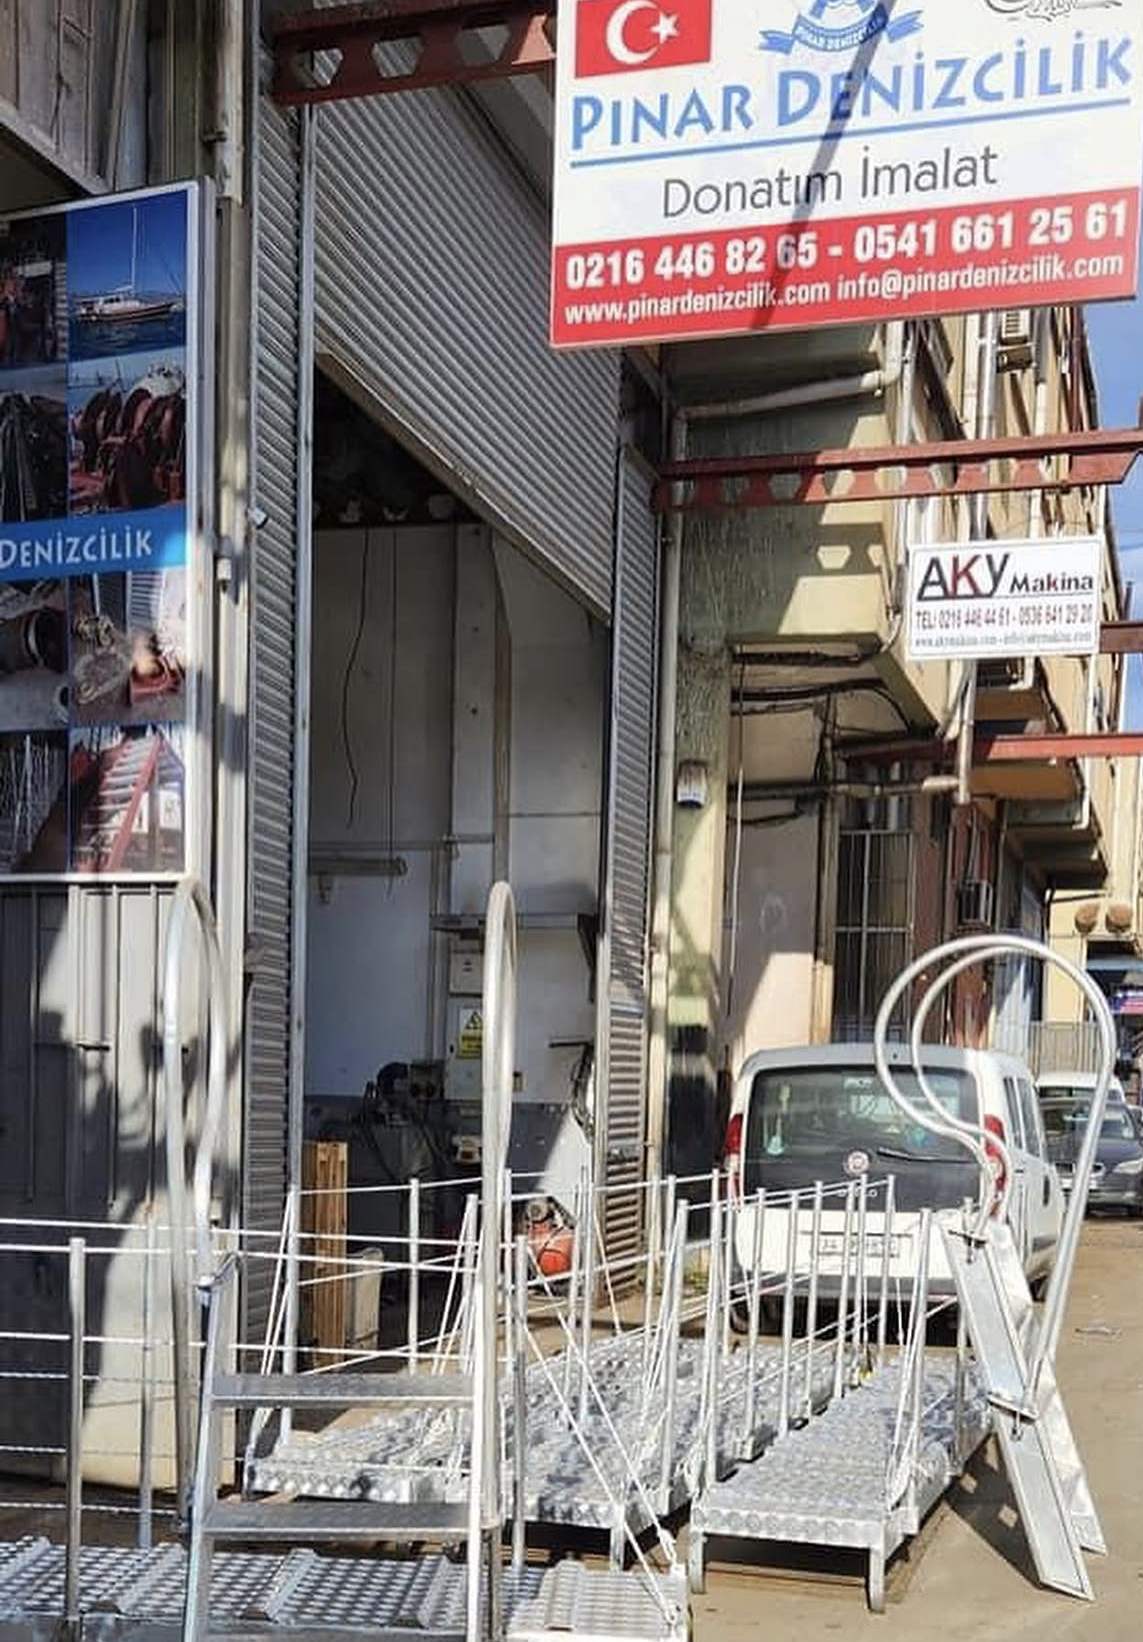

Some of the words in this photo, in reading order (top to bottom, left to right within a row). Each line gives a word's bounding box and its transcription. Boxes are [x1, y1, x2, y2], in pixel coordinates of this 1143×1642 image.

[570, 84, 752, 152] PINAR
[776, 31, 1133, 128] DENİZCİLİK
[663, 169, 843, 219] Donatım
[861, 145, 998, 199] İmalat
[566, 249, 645, 290] 0216
[654, 240, 714, 280] 446
[725, 235, 766, 276] 82
[776, 231, 818, 269] 65
[853, 219, 937, 265] 0541
[951, 214, 1013, 254] 661
[1029, 206, 1074, 246] 25
[1085, 199, 1128, 240] 61
[564, 281, 830, 325] www.pinardenizcilik.com
[836, 252, 1124, 301] info@pinardenizcilik.com
[0, 525, 153, 569] DENİZCİLİK
[1009, 571, 1095, 594] Makina
